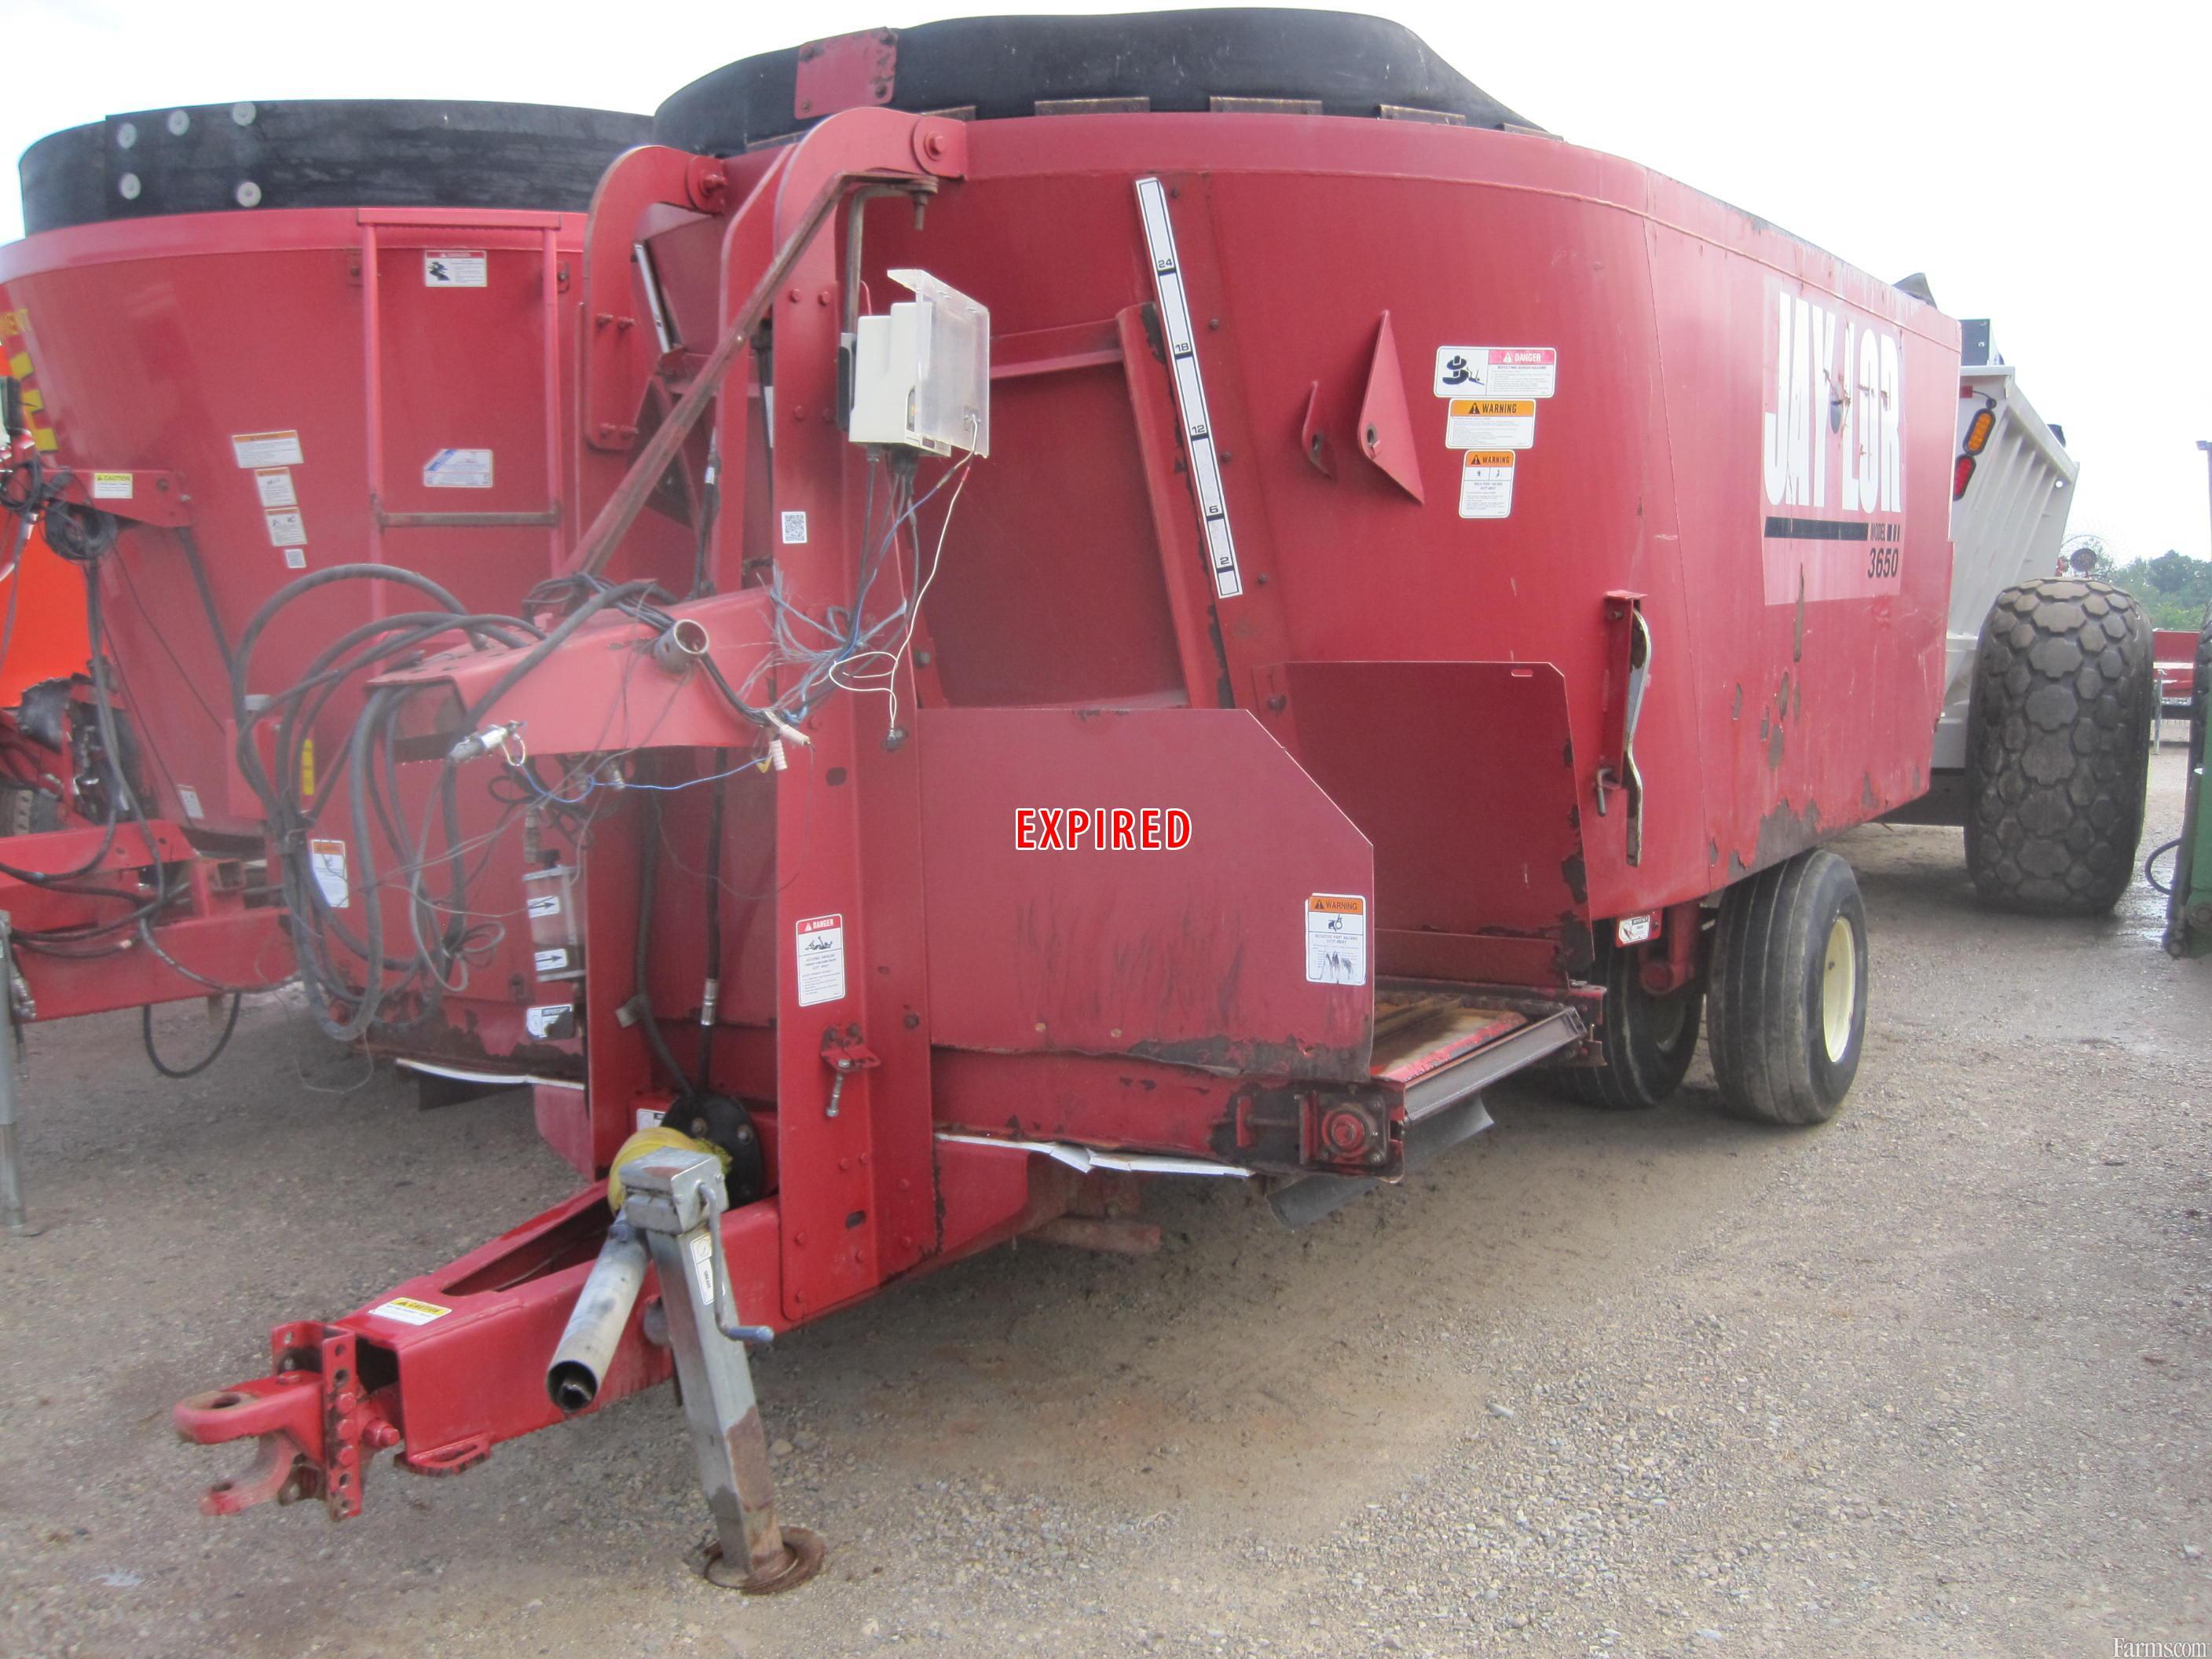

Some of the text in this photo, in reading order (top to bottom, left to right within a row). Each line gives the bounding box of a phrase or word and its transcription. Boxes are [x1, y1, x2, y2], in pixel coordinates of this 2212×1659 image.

[1157, 258, 1174, 268] 24
[1174, 342, 1189, 352] 18
[1514, 353, 1541, 362] DANGER
[1482, 403, 1517, 414] WARNING
[1192, 425, 1205, 434] 12
[1868, 548, 1899, 578] 3650
[1326, 901, 1357, 910] WARNING
[813, 919, 833, 928] DANGER
